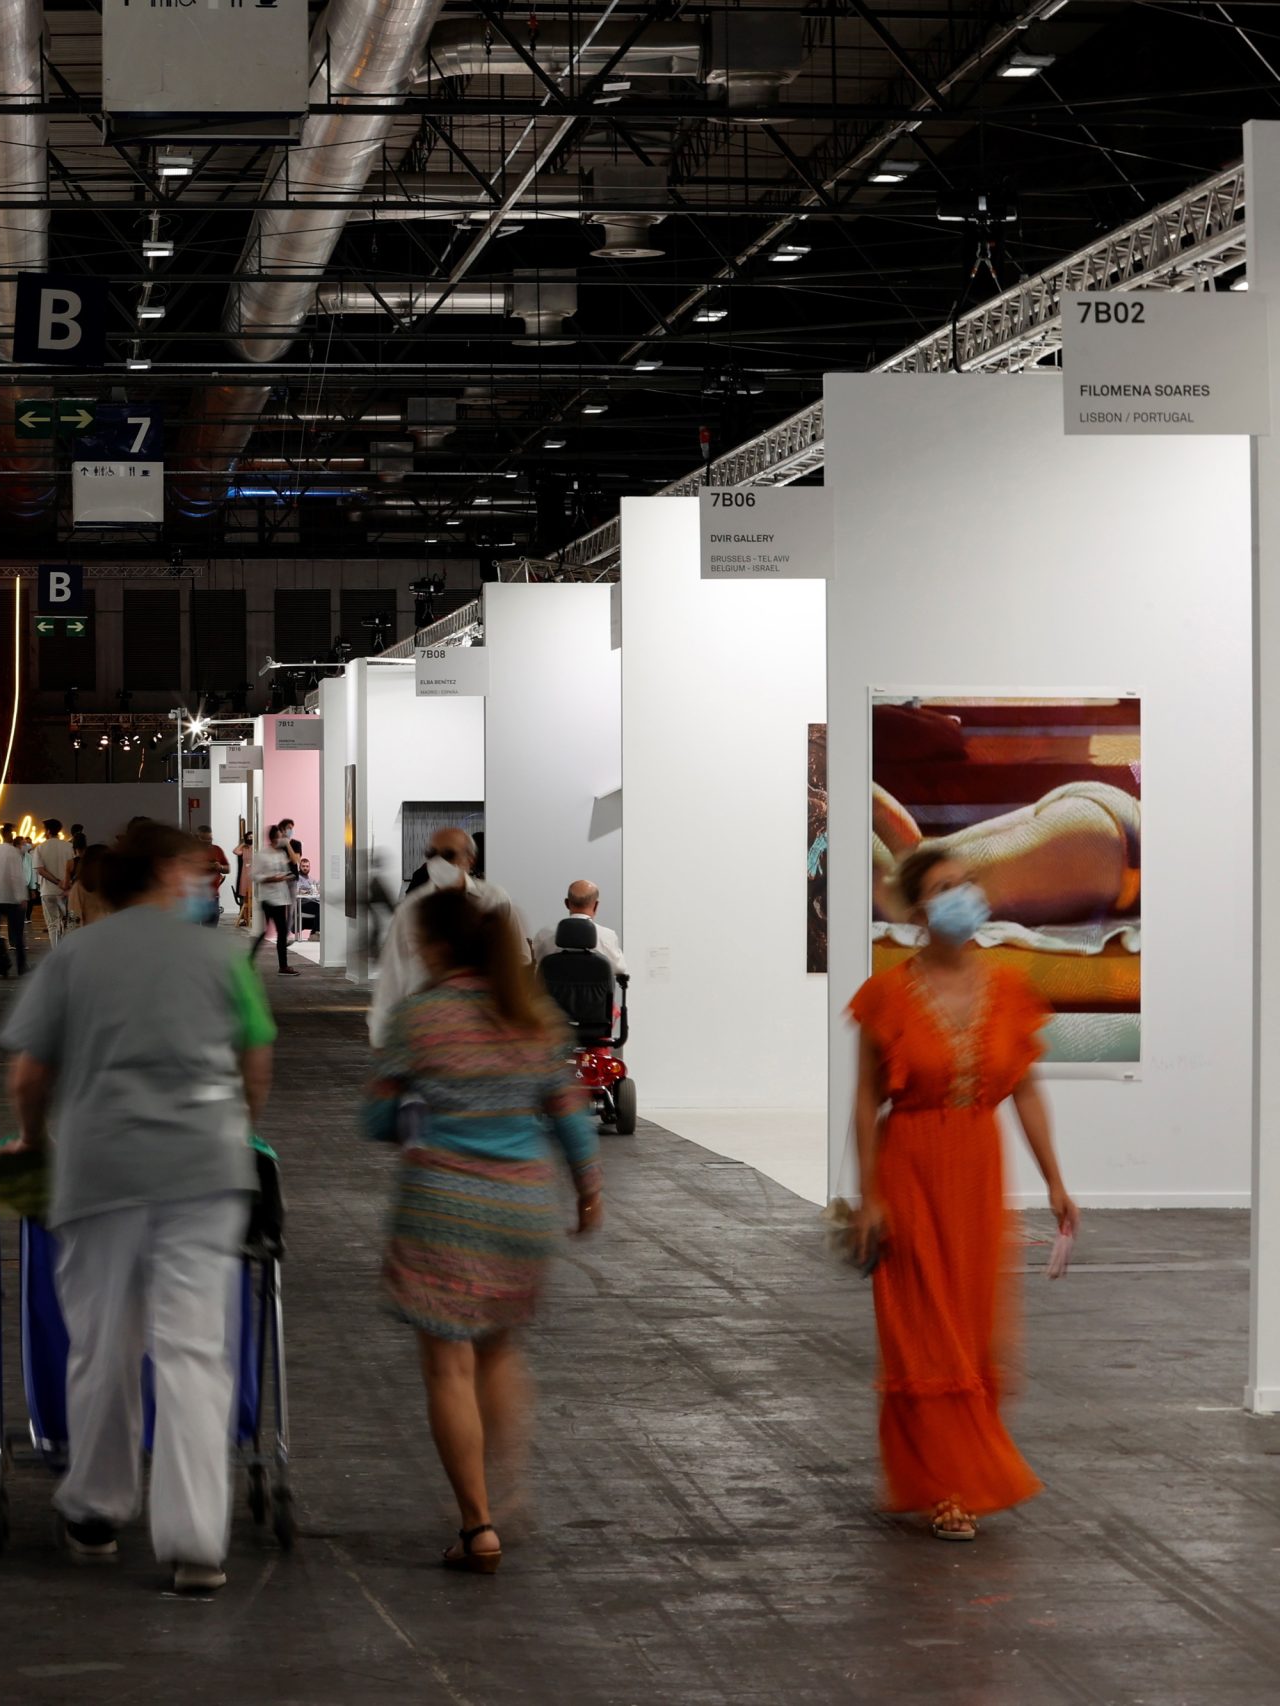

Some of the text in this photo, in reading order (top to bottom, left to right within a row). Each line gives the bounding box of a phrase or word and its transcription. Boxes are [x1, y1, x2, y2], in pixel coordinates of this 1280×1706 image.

[38, 288, 82, 350] B
[1076, 301, 1145, 324] 7B02
[1079, 384, 1210, 397] FILOMENA SOARES
[1079, 411, 1122, 423] LISBON
[1133, 411, 1194, 423] PORTUGAL
[127, 417, 151, 453] 7
[710, 492, 756, 507] 7B06
[710, 534, 775, 543] DVIR GALLERY
[710, 555, 752, 563] BRUSSELS
[758, 555, 773, 563] TEL
[773, 555, 790, 563] AVIV
[710, 564, 746, 572] BELGIUM
[752, 564, 780, 572] ISRAEL
[49, 571, 72, 602] B
[420, 650, 445, 658] 7B08
